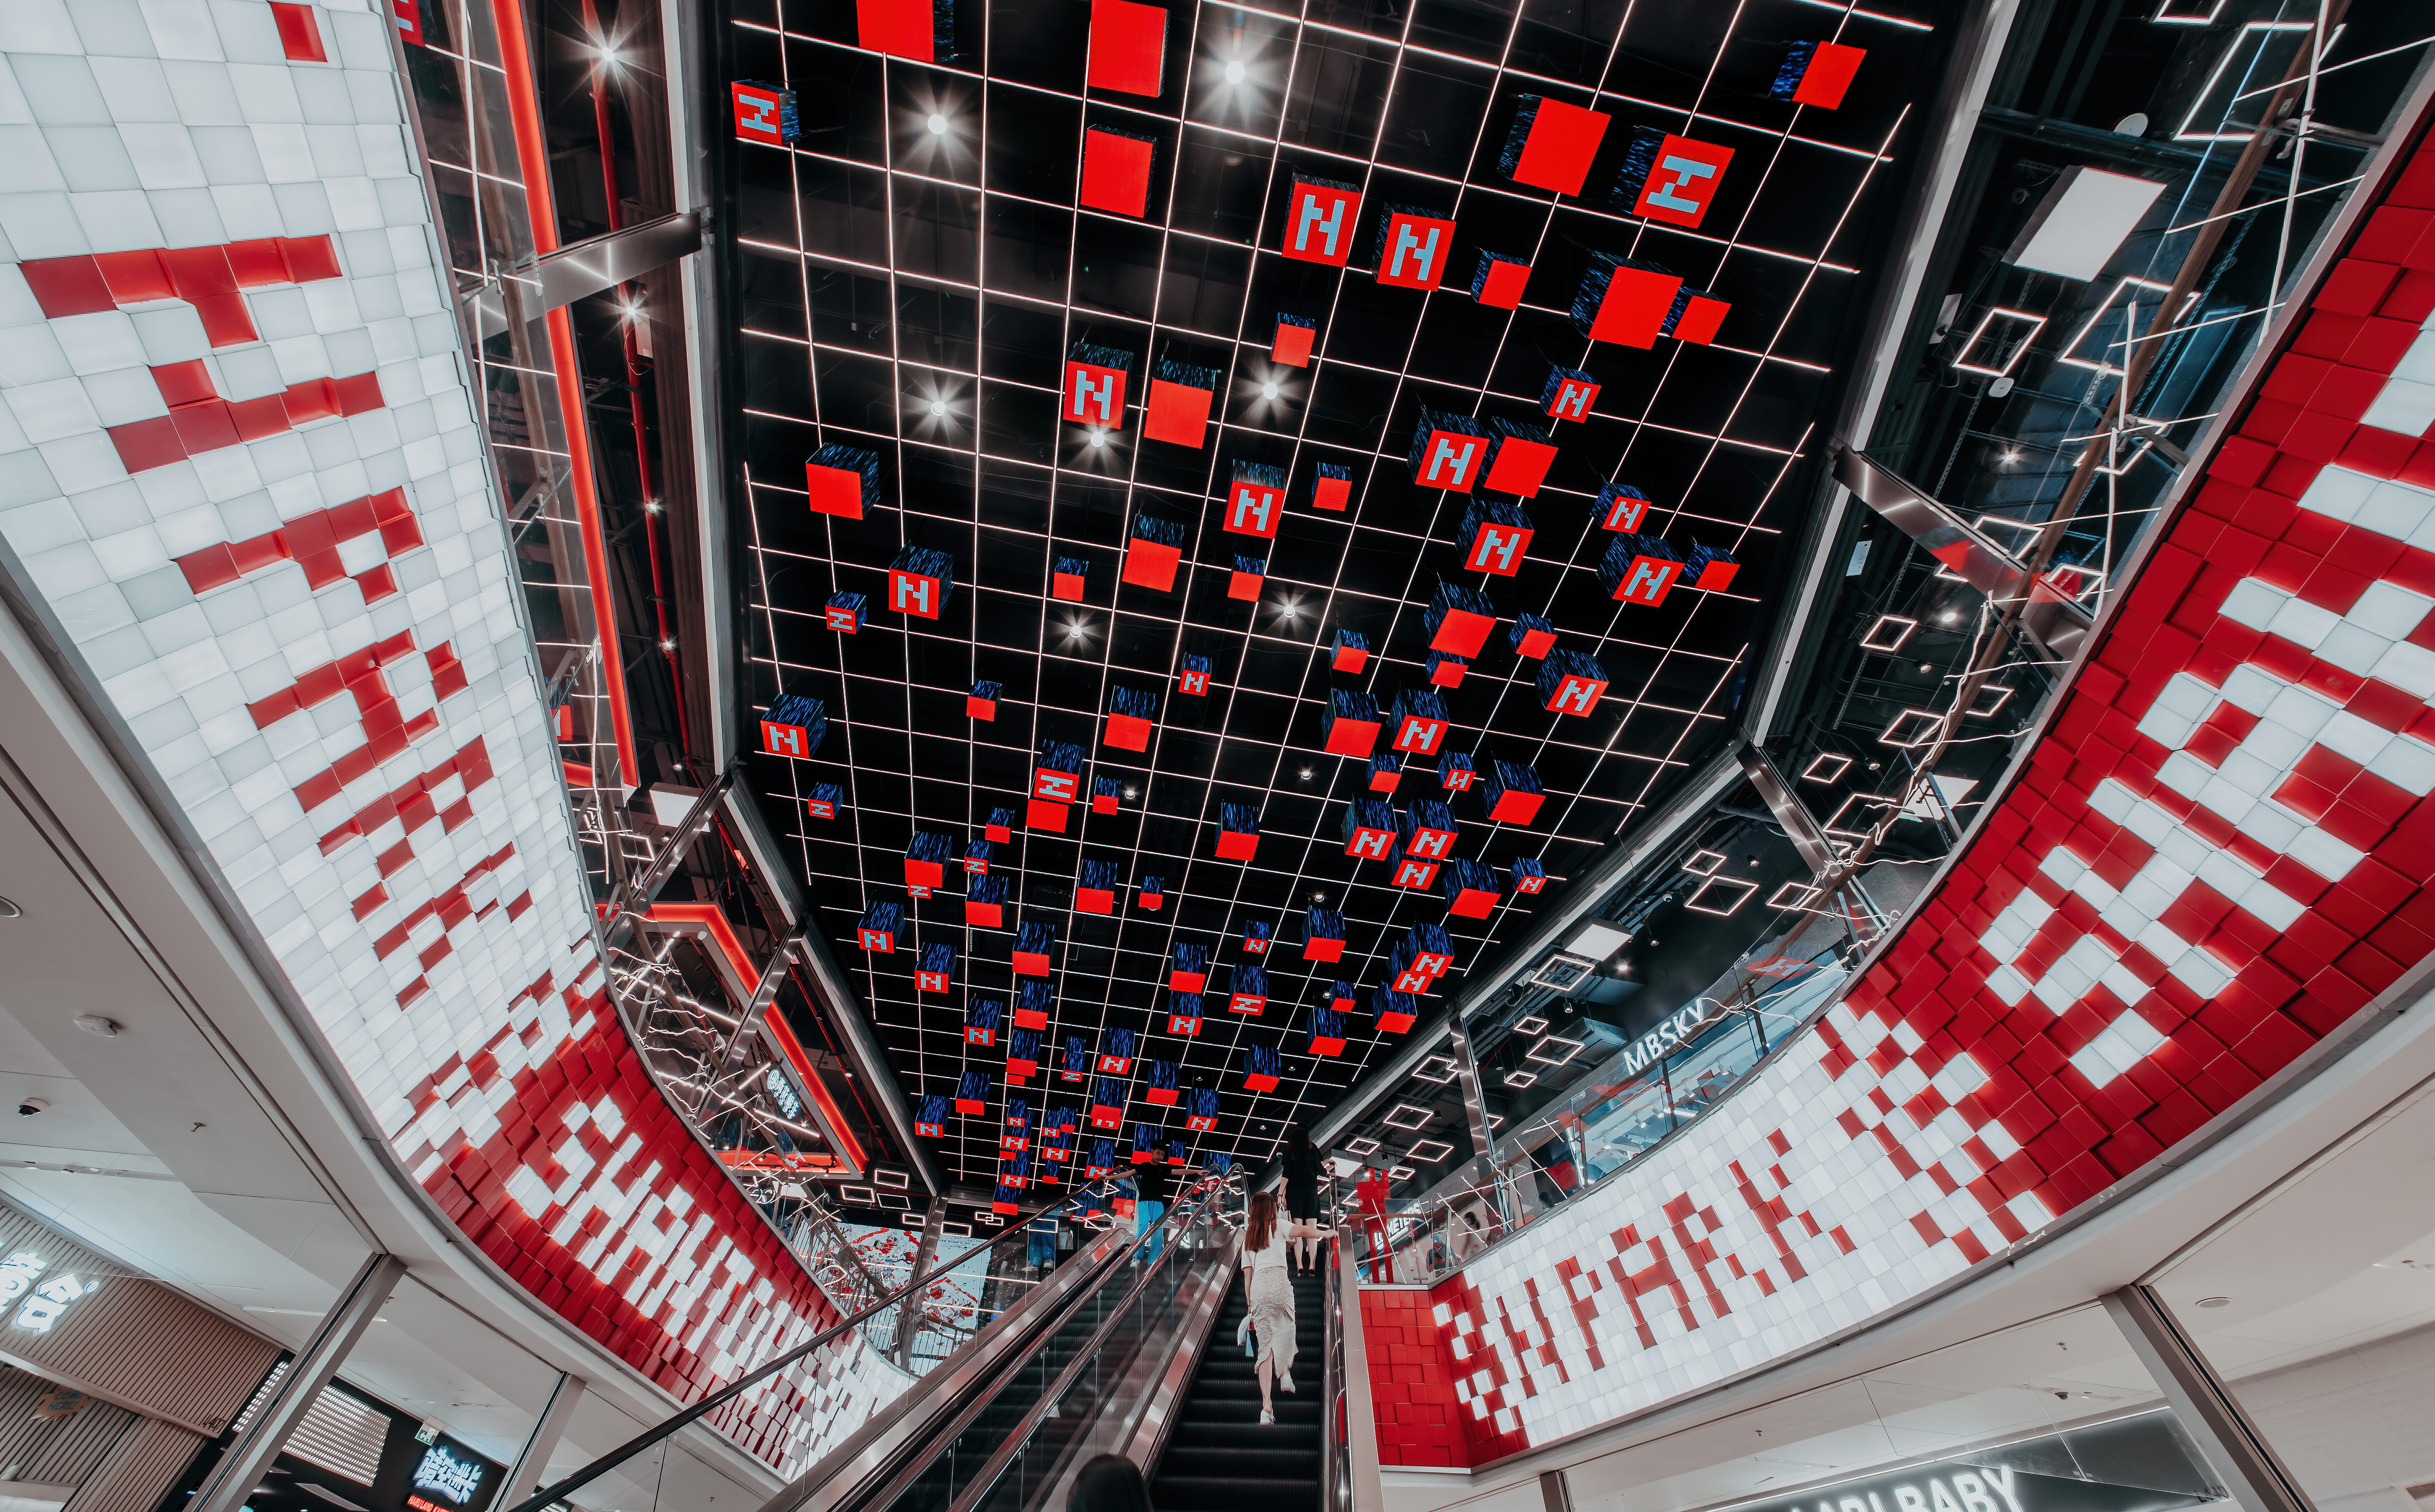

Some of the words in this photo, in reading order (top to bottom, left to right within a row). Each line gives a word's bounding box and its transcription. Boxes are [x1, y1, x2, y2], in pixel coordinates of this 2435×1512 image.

[1295, 194, 1346, 256] N
[1389, 223, 1440, 281] N
[1074, 370, 1113, 420] N
[1555, 383, 1591, 417] N
[1427, 438, 1475, 485] N
[1233, 488, 1273, 532] N
[1609, 501, 1642, 530] N
[1476, 529, 1521, 570] N
[897, 575, 929, 613] N
[1624, 562, 1671, 601] N
[1184, 673, 1204, 693] N
[1555, 679, 1597, 712] N
[1978, 307, 2435, 1089] SHAN
[769, 726, 800, 754] N
[1401, 720, 1438, 750] N
[1354, 831, 1387, 856] N
[1414, 831, 1448, 856] N
[1399, 863, 1430, 886] N
[864, 931, 887, 950] N
[1416, 954, 1445, 974] N
[920, 973, 941, 991] N
[1398, 973, 1426, 992] N
[1173, 1017, 1196, 1034] N
[1623, 997, 1705, 1075] MBSKY
